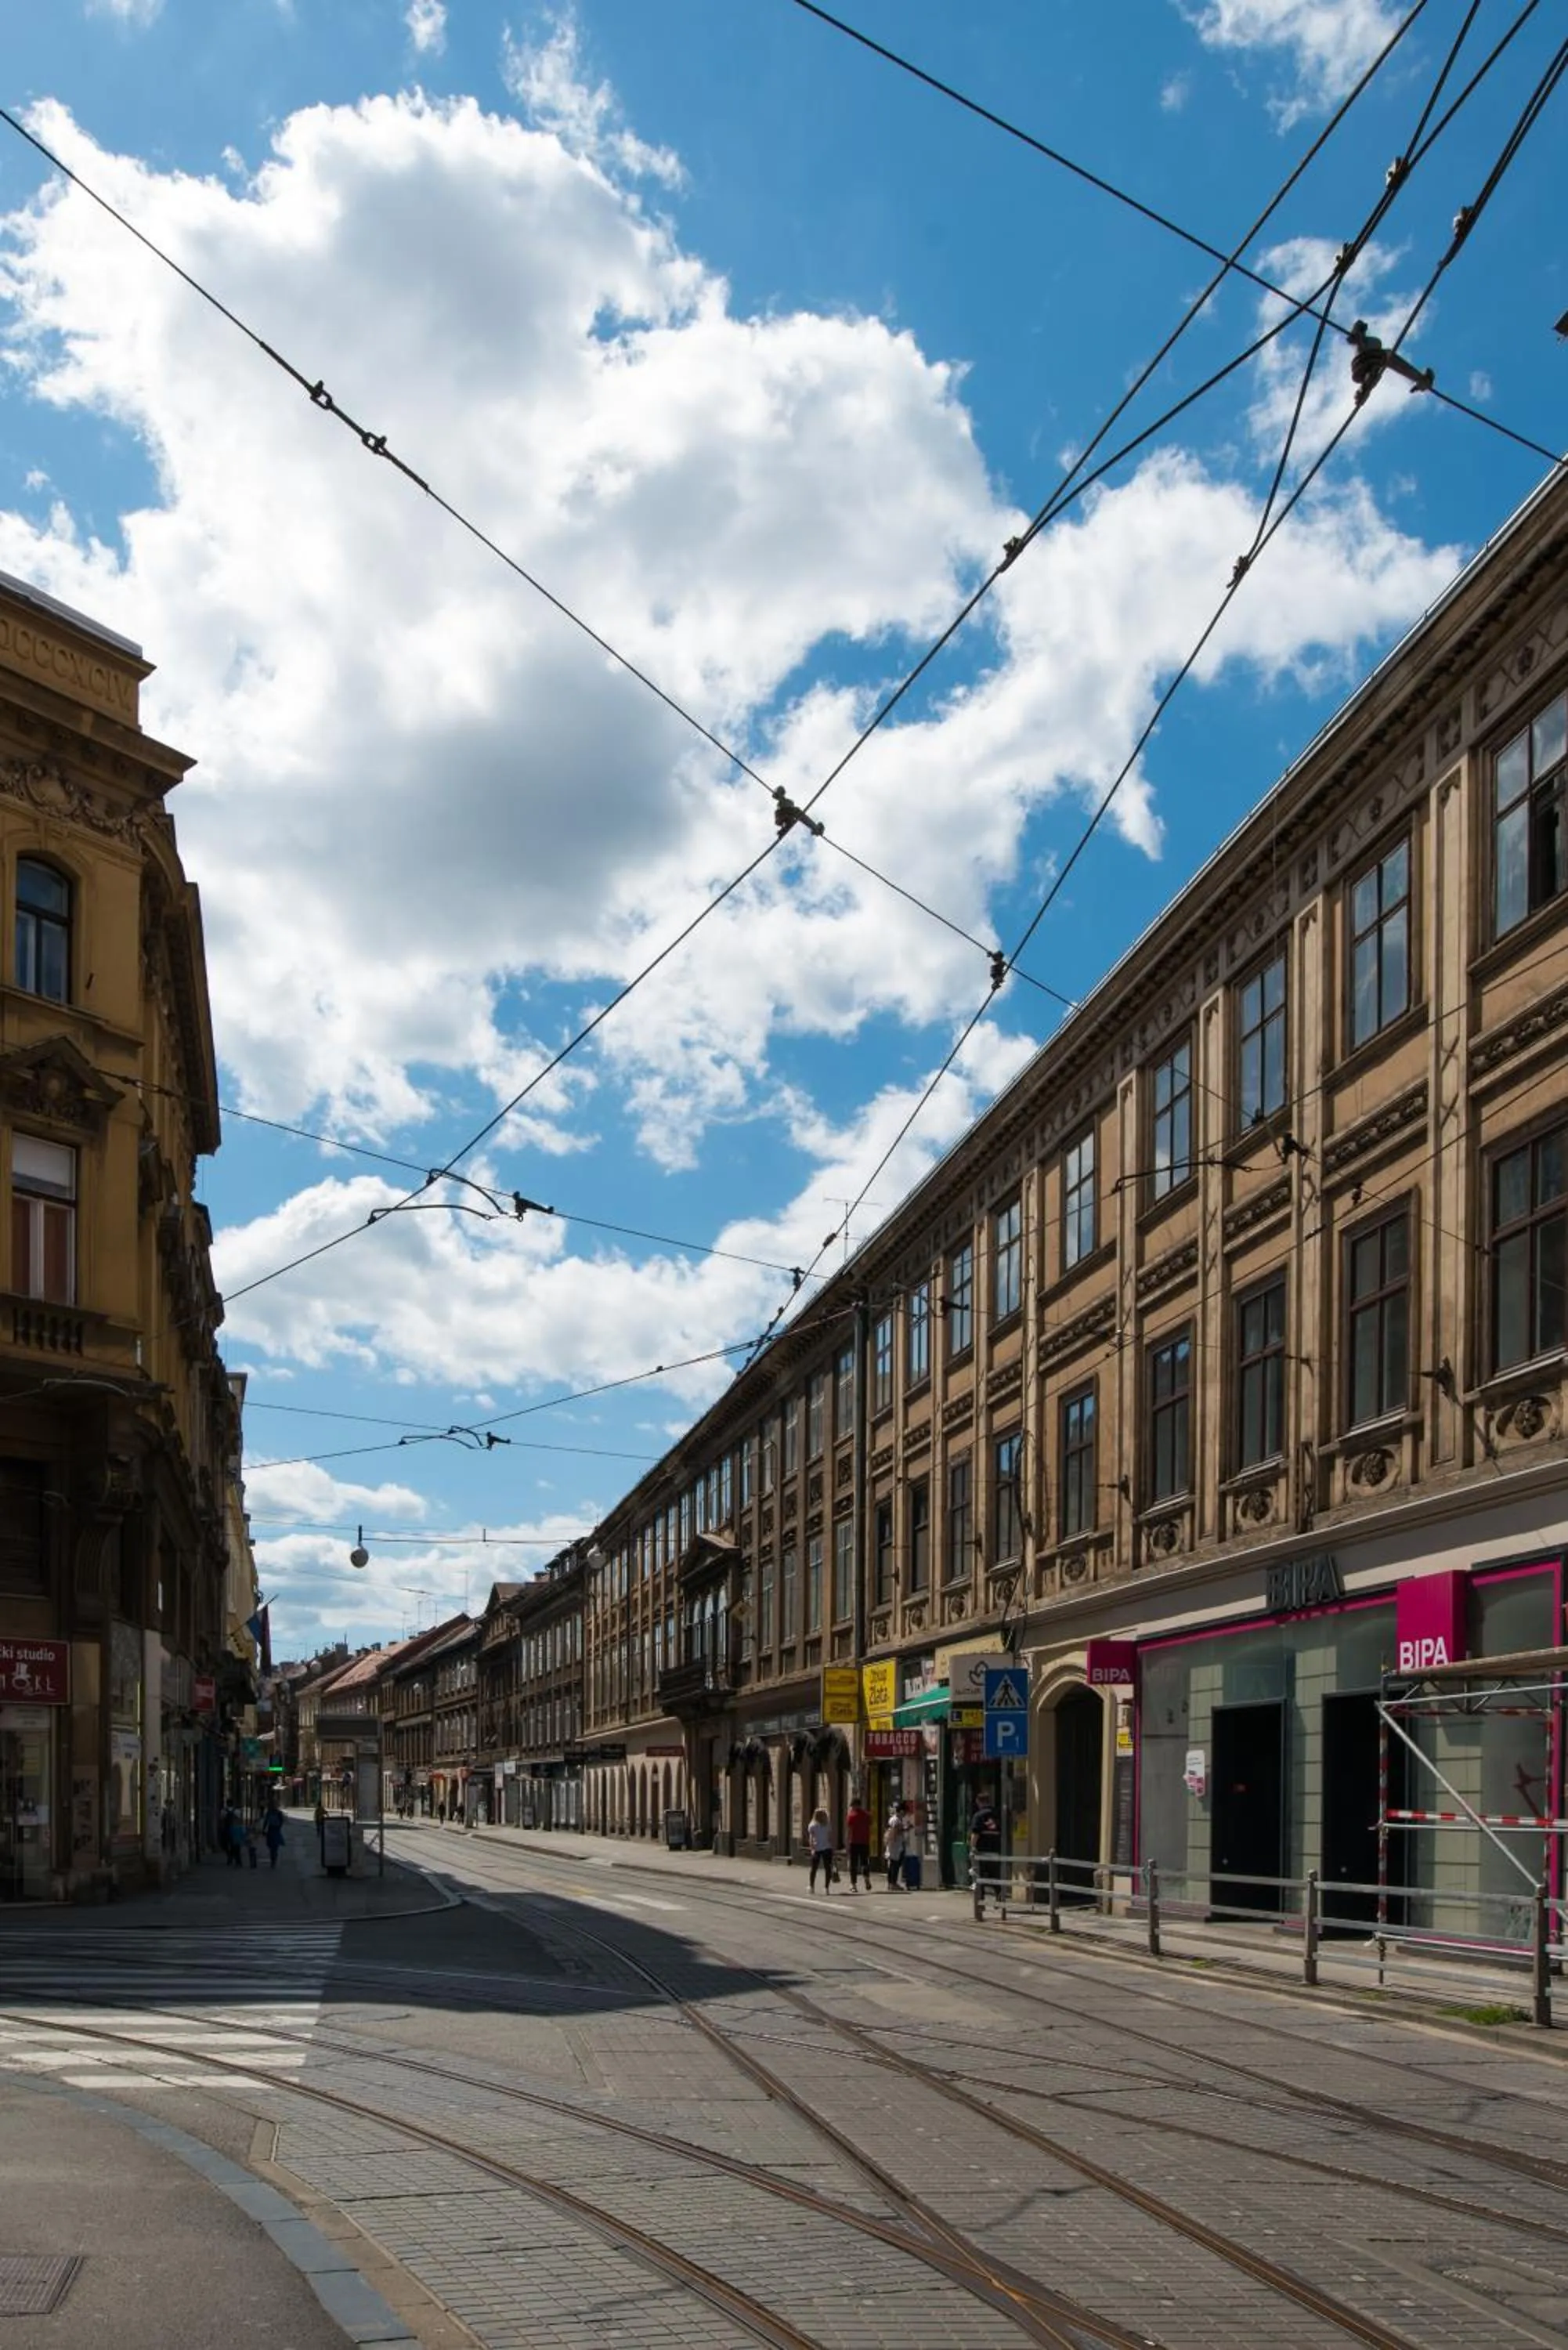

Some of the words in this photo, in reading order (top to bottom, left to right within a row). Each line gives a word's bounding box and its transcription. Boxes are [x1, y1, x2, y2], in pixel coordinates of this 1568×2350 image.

[1266, 1554, 1343, 1610] BIPA
[16, 1647, 56, 1661] studio
[1400, 1636, 1448, 1672] BIPA
[1093, 1668, 1131, 1683] BIPA
[867, 1732, 917, 1745] TOBACCO
